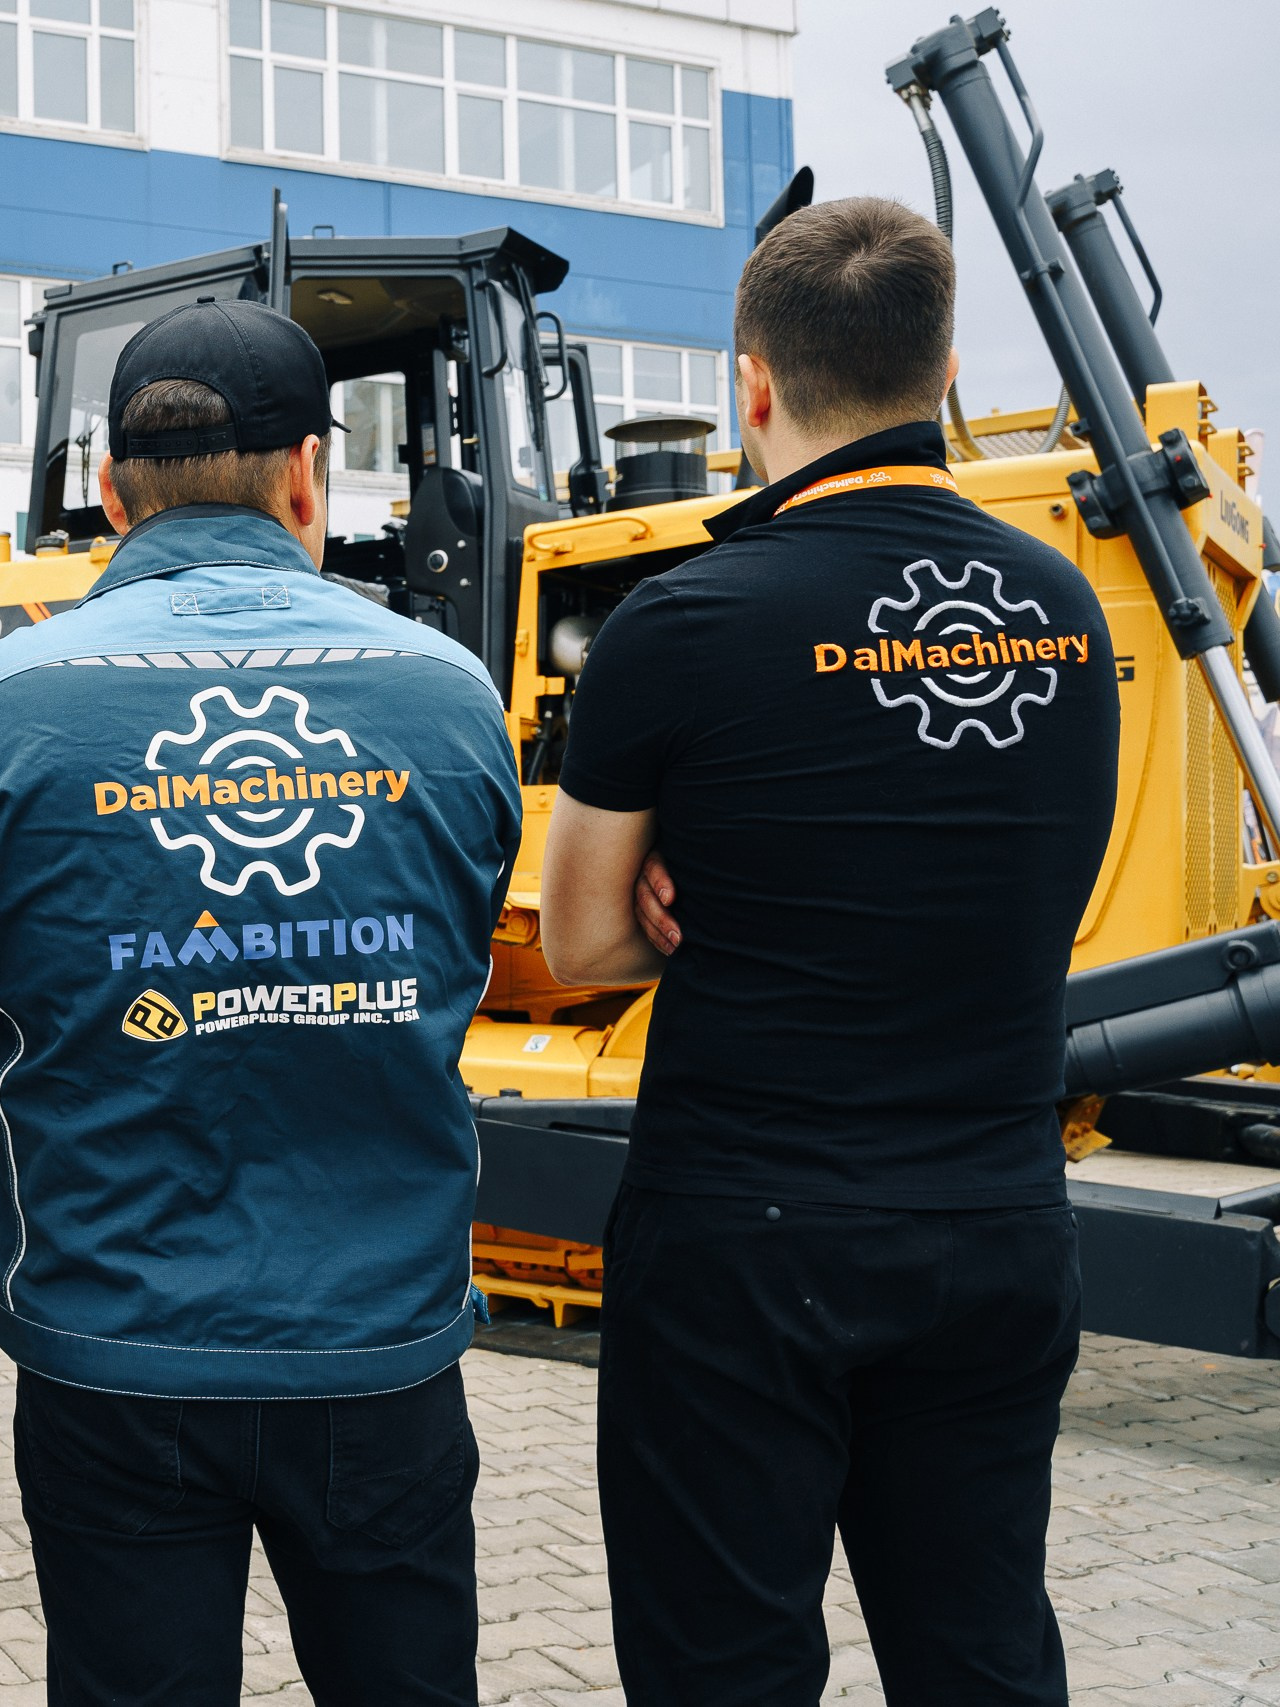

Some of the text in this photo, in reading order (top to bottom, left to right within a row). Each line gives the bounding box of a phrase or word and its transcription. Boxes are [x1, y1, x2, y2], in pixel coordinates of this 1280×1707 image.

[813, 632, 1089, 673] DalMachinery
[93, 766, 411, 816] DalMachinery
[108, 910, 415, 971] FAMBITION
[192, 977, 418, 1022] POWERPLUS
[195, 1012, 290, 1036] POWERPLUS
[293, 1013, 348, 1026] GROUP
[393, 1010, 420, 1023] USA
